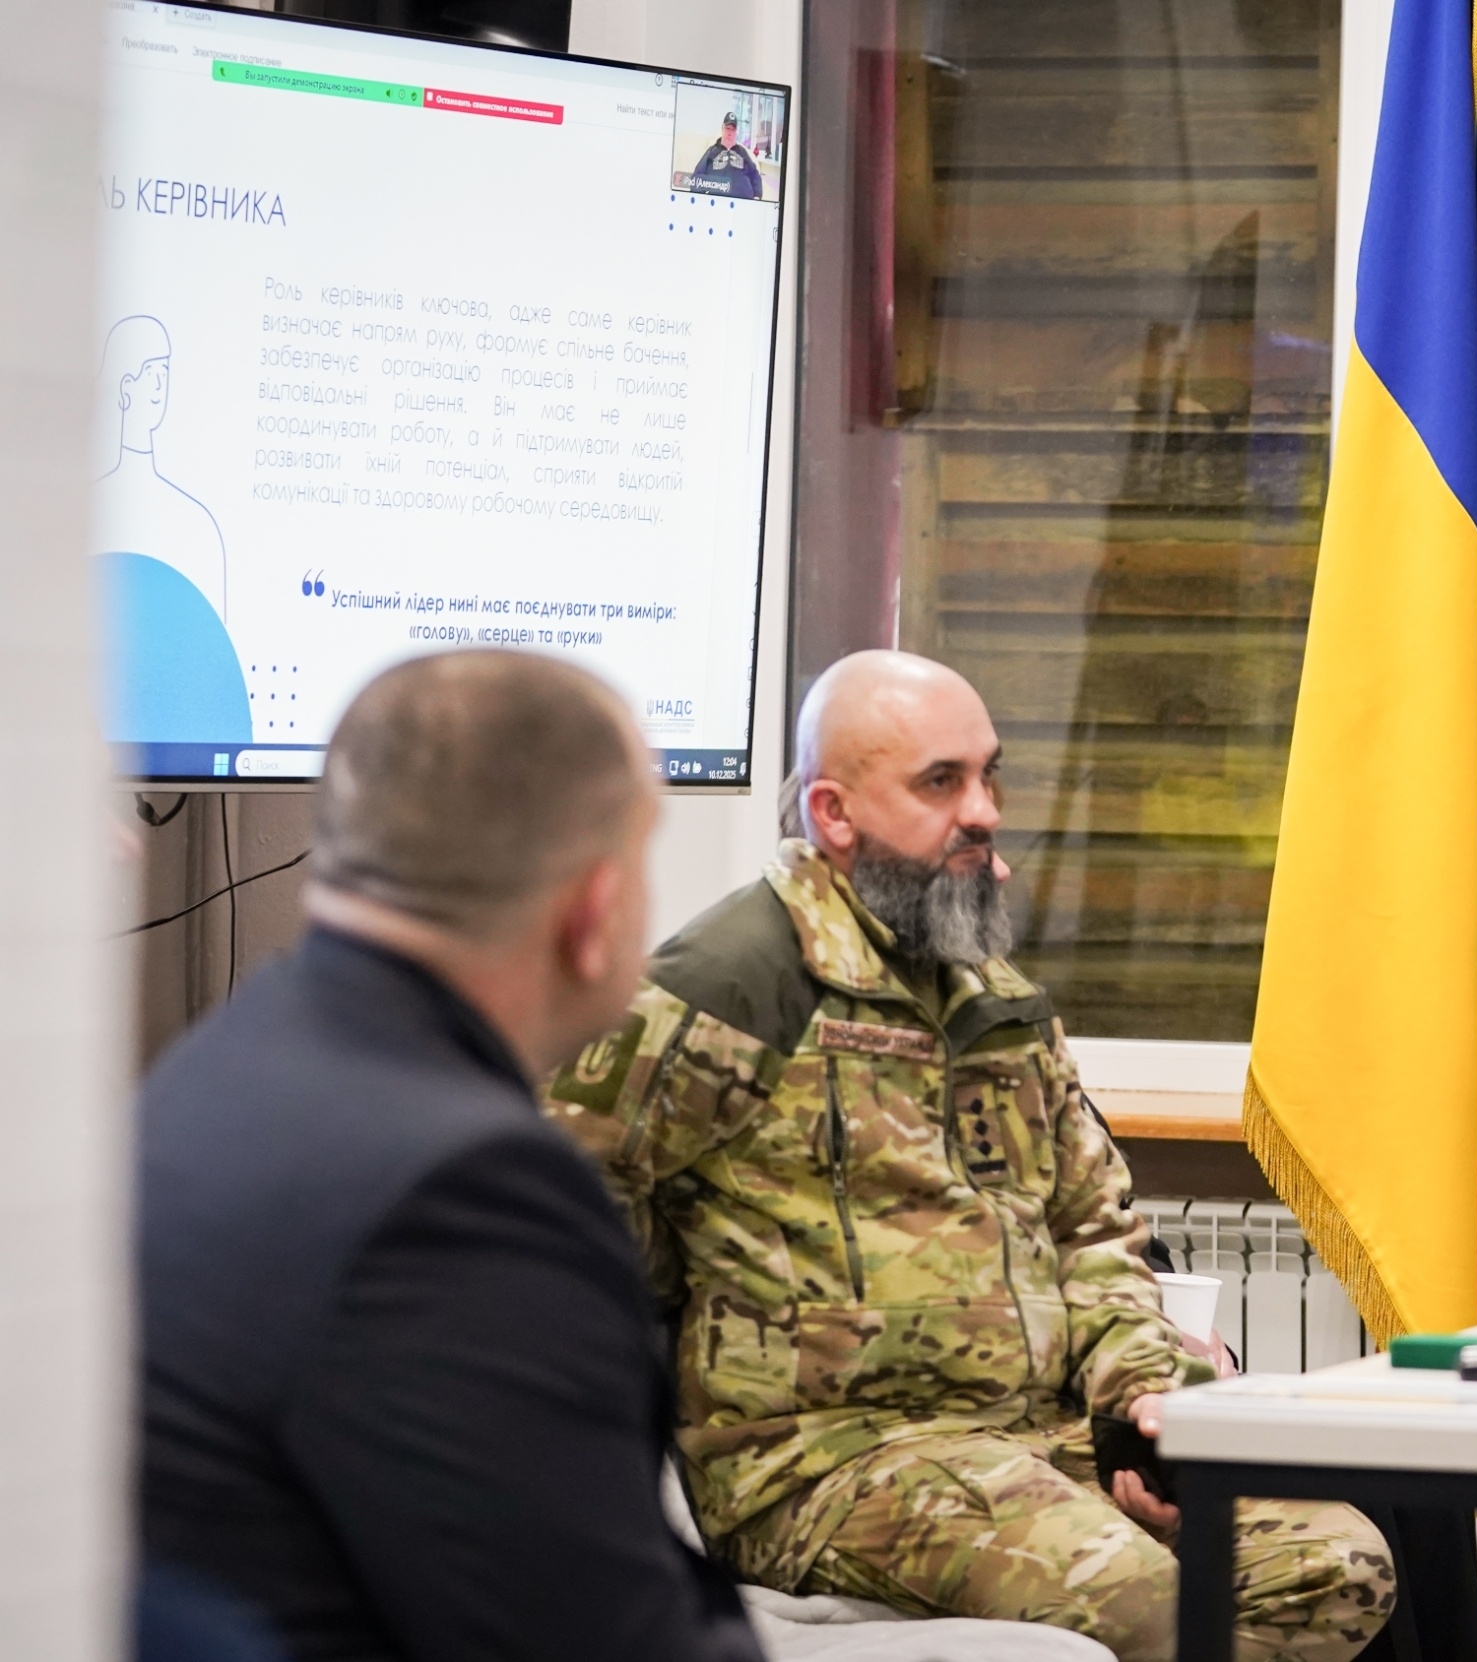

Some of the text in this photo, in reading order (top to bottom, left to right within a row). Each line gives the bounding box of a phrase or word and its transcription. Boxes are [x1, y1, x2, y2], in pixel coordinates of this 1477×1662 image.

[245, 70, 364, 94] Вы запустили демонстрацию экрана
[436, 95, 554, 118] Остановить совместное использование
[616, 103, 636, 114] Найти
[638, 107, 654, 117] текст
[655, 110, 667, 119] или
[136, 177, 287, 227] КЕРІВНИКА
[264, 276, 693, 338] Роль керівників ключова, адже саме керівник
[262, 315, 689, 370] визначає напрям руху, формує спільне бачення,
[259, 345, 360, 376] забезпечує
[381, 357, 481, 383] організацію
[501, 368, 574, 390] процесів
[616, 376, 689, 399] приймає
[258, 377, 687, 430] відповідальні рішення. Він має не лише
[256, 415, 684, 464] координувати роботу, а й підтримувати людей,
[254, 449, 683, 494] розвивати їхній потенціал, сприяти відкритій
[252, 480, 664, 526] комунікації та здоровому робочому середовищу.
[331, 589, 677, 623] Успішний лідер нині має поєднувати три виміри:
[409, 625, 603, 648] «голову», «серце» та «руки»
[655, 700, 693, 717] НАДС
[708, 770, 737, 780] 10.12.2025
[722, 757, 737, 767] 12:04
